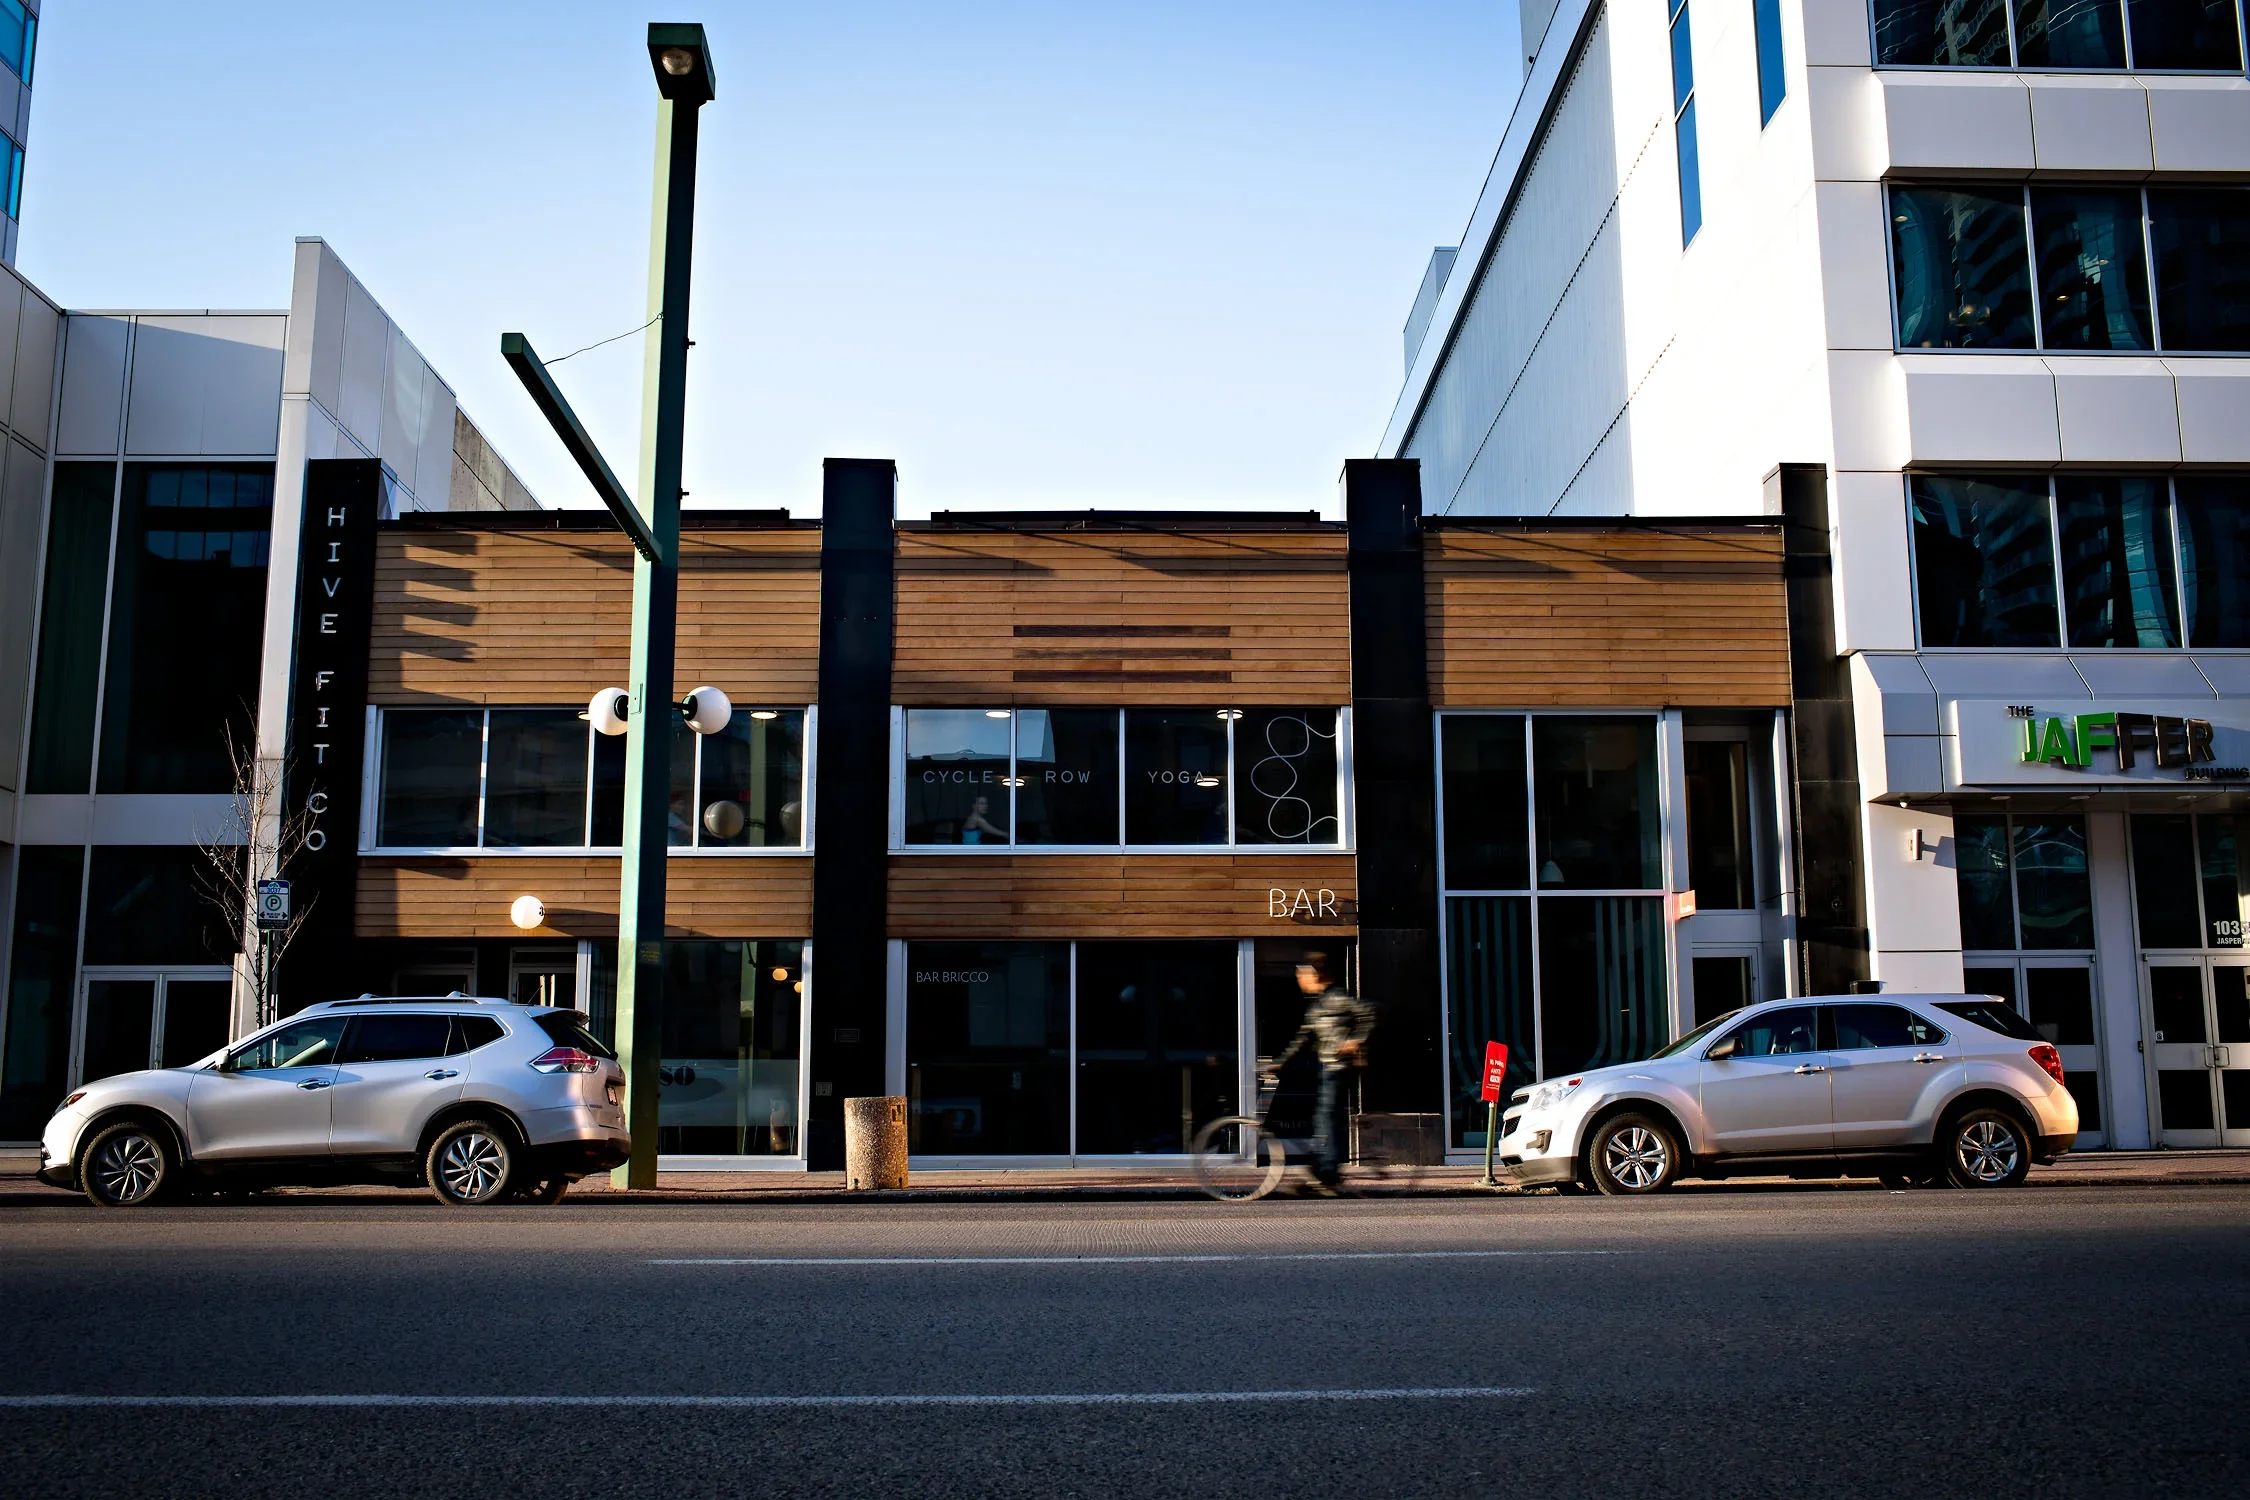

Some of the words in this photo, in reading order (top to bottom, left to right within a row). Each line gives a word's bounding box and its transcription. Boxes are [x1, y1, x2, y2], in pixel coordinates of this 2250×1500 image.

[320, 507, 346, 634] HIVE
[313, 671, 334, 765] FIT
[2005, 705, 2034, 717] THE
[2021, 712, 2217, 770] JAFFER
[922, 770, 993, 783] CYCLE
[1045, 770, 1091, 783] ROW
[1148, 770, 1205, 783] YOGA
[2185, 767, 2250, 779] BUILDING
[305, 792, 328, 851] CO
[1269, 888, 1337, 918] BAR
[2217, 937, 2242, 945] JASPER
[916, 971, 940, 982] BAR
[942, 971, 989, 982] BRICCO
